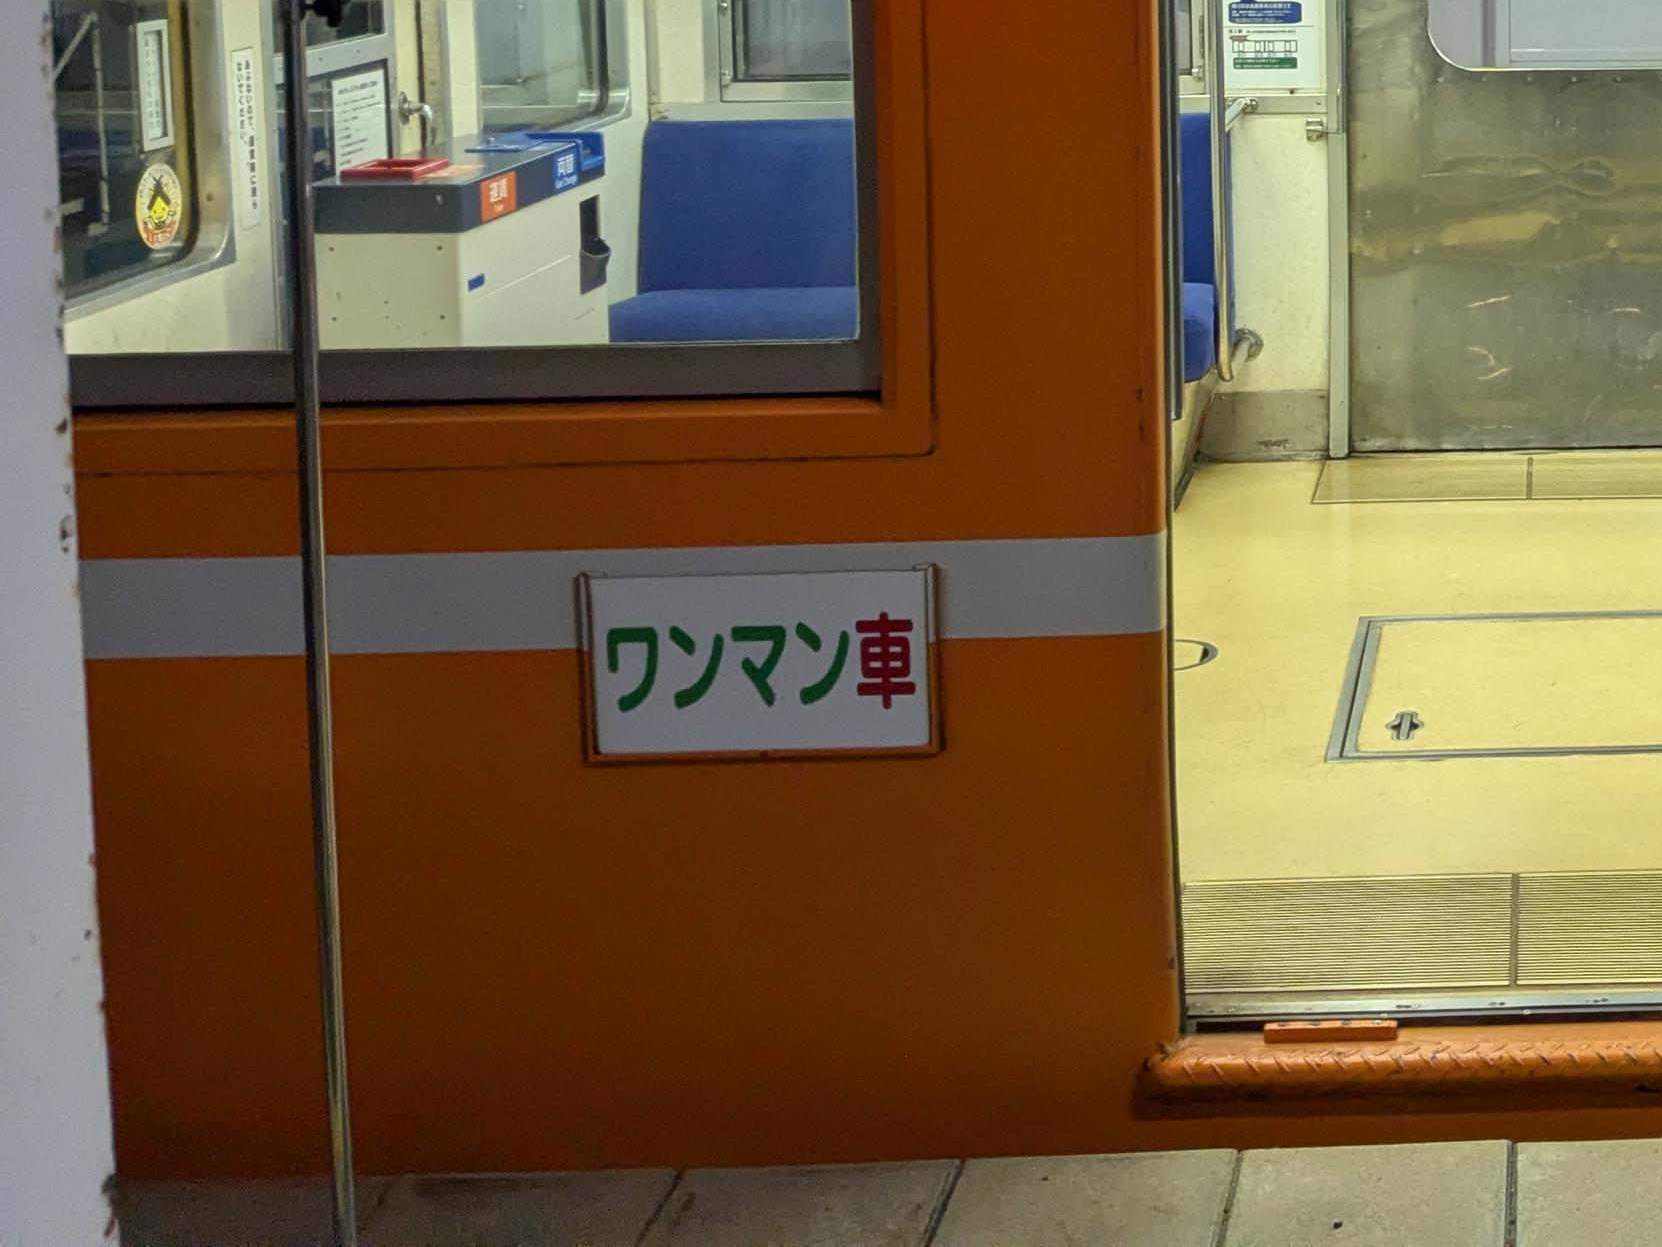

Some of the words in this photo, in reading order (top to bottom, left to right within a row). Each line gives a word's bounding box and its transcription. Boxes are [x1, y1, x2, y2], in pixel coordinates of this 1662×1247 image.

[606, 611, 917, 713] ワンマン車
